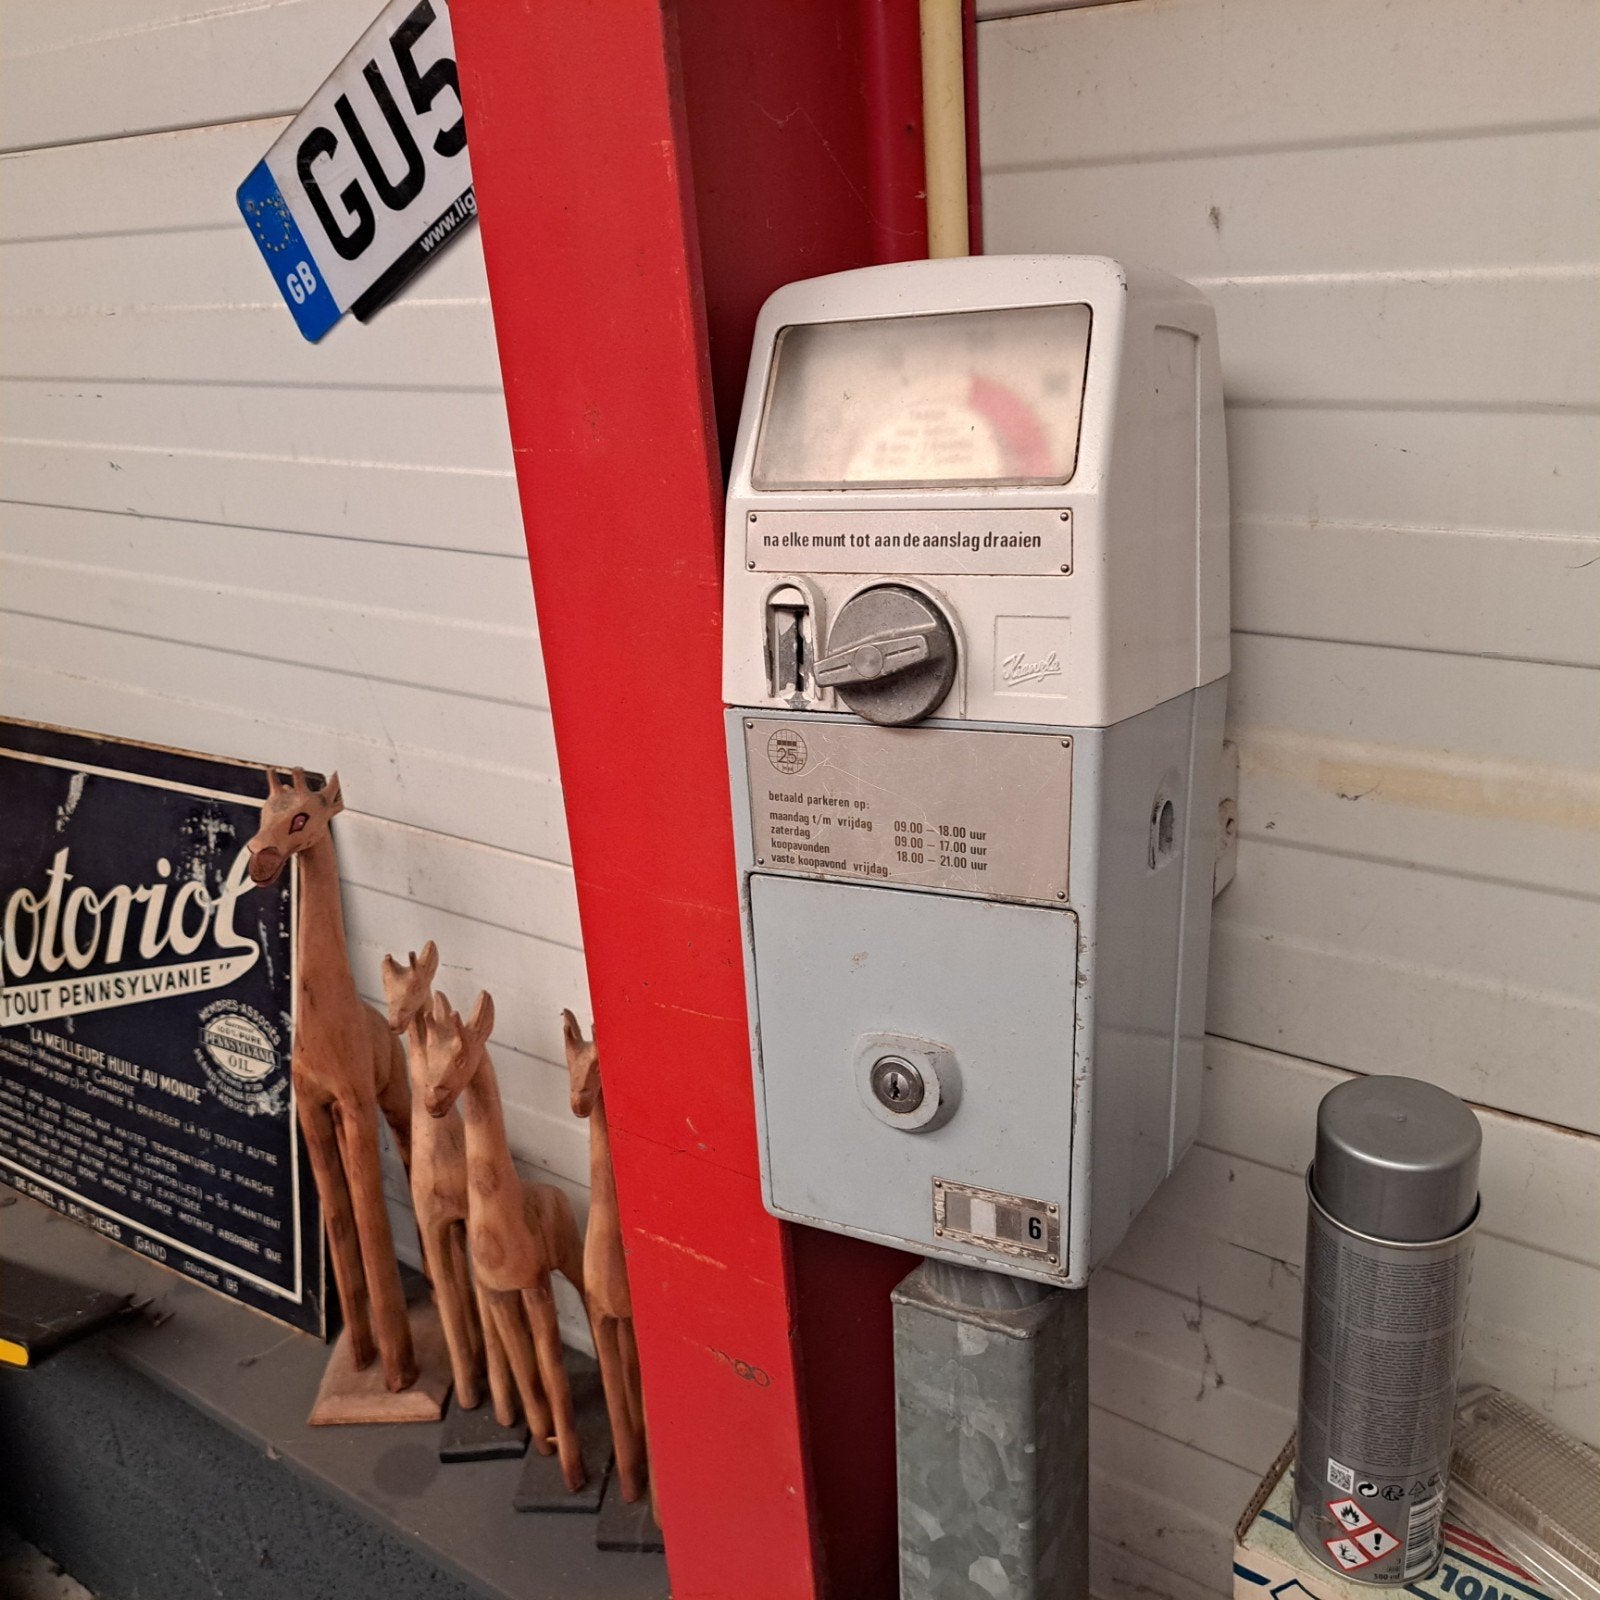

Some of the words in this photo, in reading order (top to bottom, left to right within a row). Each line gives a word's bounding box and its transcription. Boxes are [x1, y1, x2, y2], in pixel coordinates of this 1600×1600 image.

[297, 0, 467, 260] GU5
[286, 260, 317, 304] GB
[763, 536, 779, 548] na
[782, 532, 809, 547] elke
[812, 533, 846, 547] munt
[850, 533, 870, 548] tot
[874, 535, 901, 548] aan
[903, 532, 920, 548] de
[922, 531, 980, 551] aanslag
[983, 531, 1041, 548] draaien
[776, 747, 798, 764] 25
[768, 790, 804, 804] betaald
[807, 794, 850, 809] parkeren
[854, 799, 870, 811] op:
[769, 810, 810, 826] maandag
[812, 813, 832, 826] t/m
[837, 815, 873, 832] vrijdag
[894, 820, 923, 834] 09.00
[938, 825, 966, 839] 18.00
[969, 829, 987, 840] uur
[770, 825, 811, 840] zaterdag
[894, 835, 923, 849] 09.00
[939, 840, 967, 854] 17.00
[970, 845, 987, 856] uur
[771, 838, 830, 854] koopavonden
[896, 850, 924, 864] 18.00
[940, 855, 968, 869] 21.00
[971, 860, 988, 871] uur
[771, 853, 796, 867] vaste
[798, 855, 847, 871] koopavond
[853, 861, 892, 877] vrijdag.
[0, 839, 259, 978] otoriol
[2, 988, 52, 1018] TOUT
[44, 1031, 106, 1070] MEILLEURE
[106, 1055, 141, 1082] HUILE
[141, 1069, 158, 1089] AU
[228, 1055, 253, 1073] OIL
[1028, 1217, 1042, 1240] 6
[134, 1235, 167, 1262] GAND
